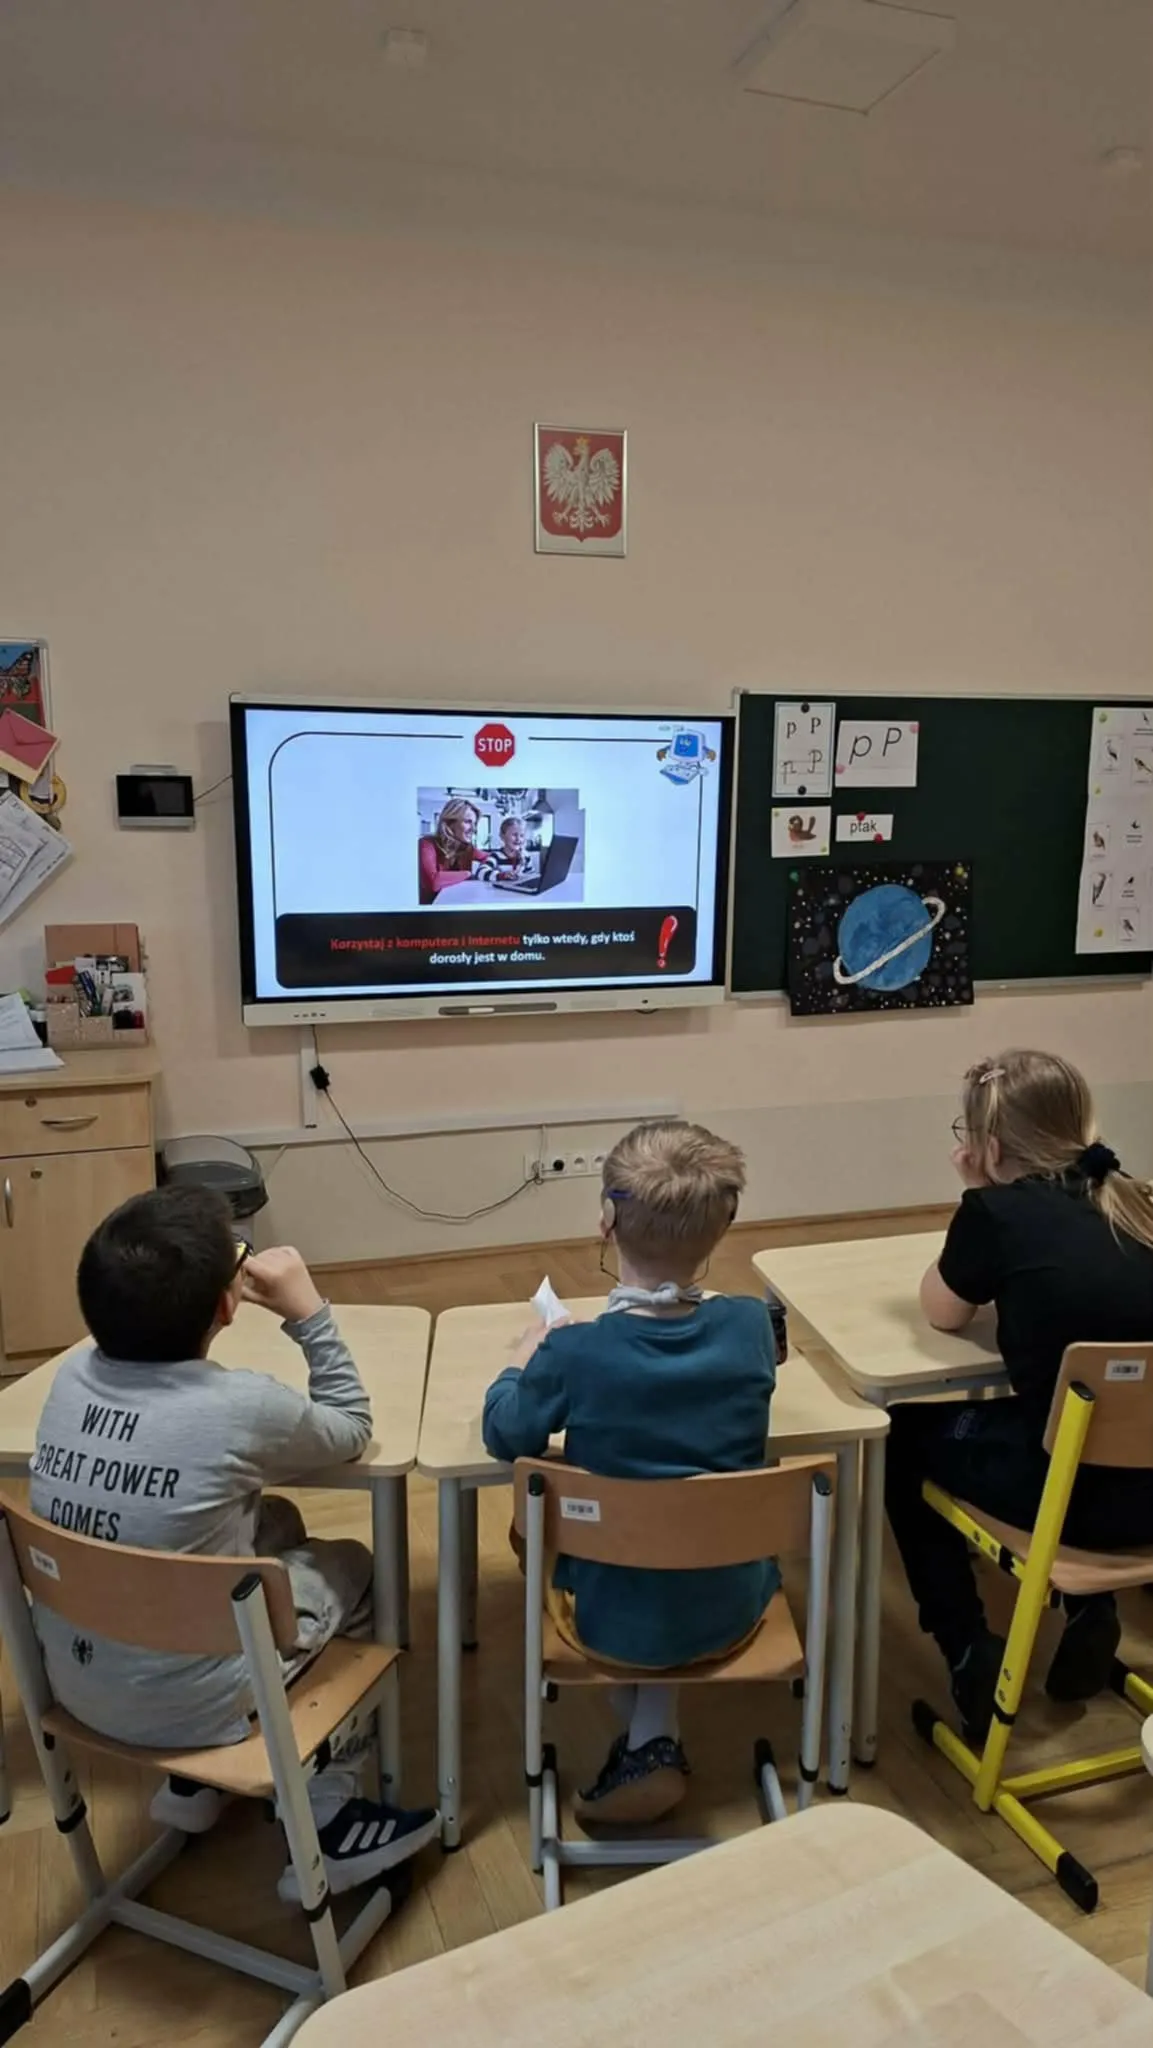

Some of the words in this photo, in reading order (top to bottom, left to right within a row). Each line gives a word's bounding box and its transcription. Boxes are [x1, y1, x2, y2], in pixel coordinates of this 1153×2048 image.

[786, 721, 797, 739] p
[810, 716, 821, 735] P
[478, 738, 512, 752] STOP
[848, 734, 873, 766] p
[882, 726, 903, 757] P
[850, 819, 877, 837] ptak
[331, 937, 384, 951] Korzystaj
[396, 935, 458, 949] komputera
[522, 932, 550, 946] tylko
[552, 932, 588, 945] wtedy,
[590, 931, 610, 944] gdy
[612, 930, 635, 942] ktoś
[429, 951, 472, 965] dorosły
[474, 951, 495, 965] jest
[497, 952, 508, 962] w
[510, 950, 546, 962] domu.
[81, 1403, 140, 1442] WITH
[34, 1443, 87, 1483] GREAT
[89, 1457, 180, 1498] POWER
[50, 1497, 121, 1542] COMES
